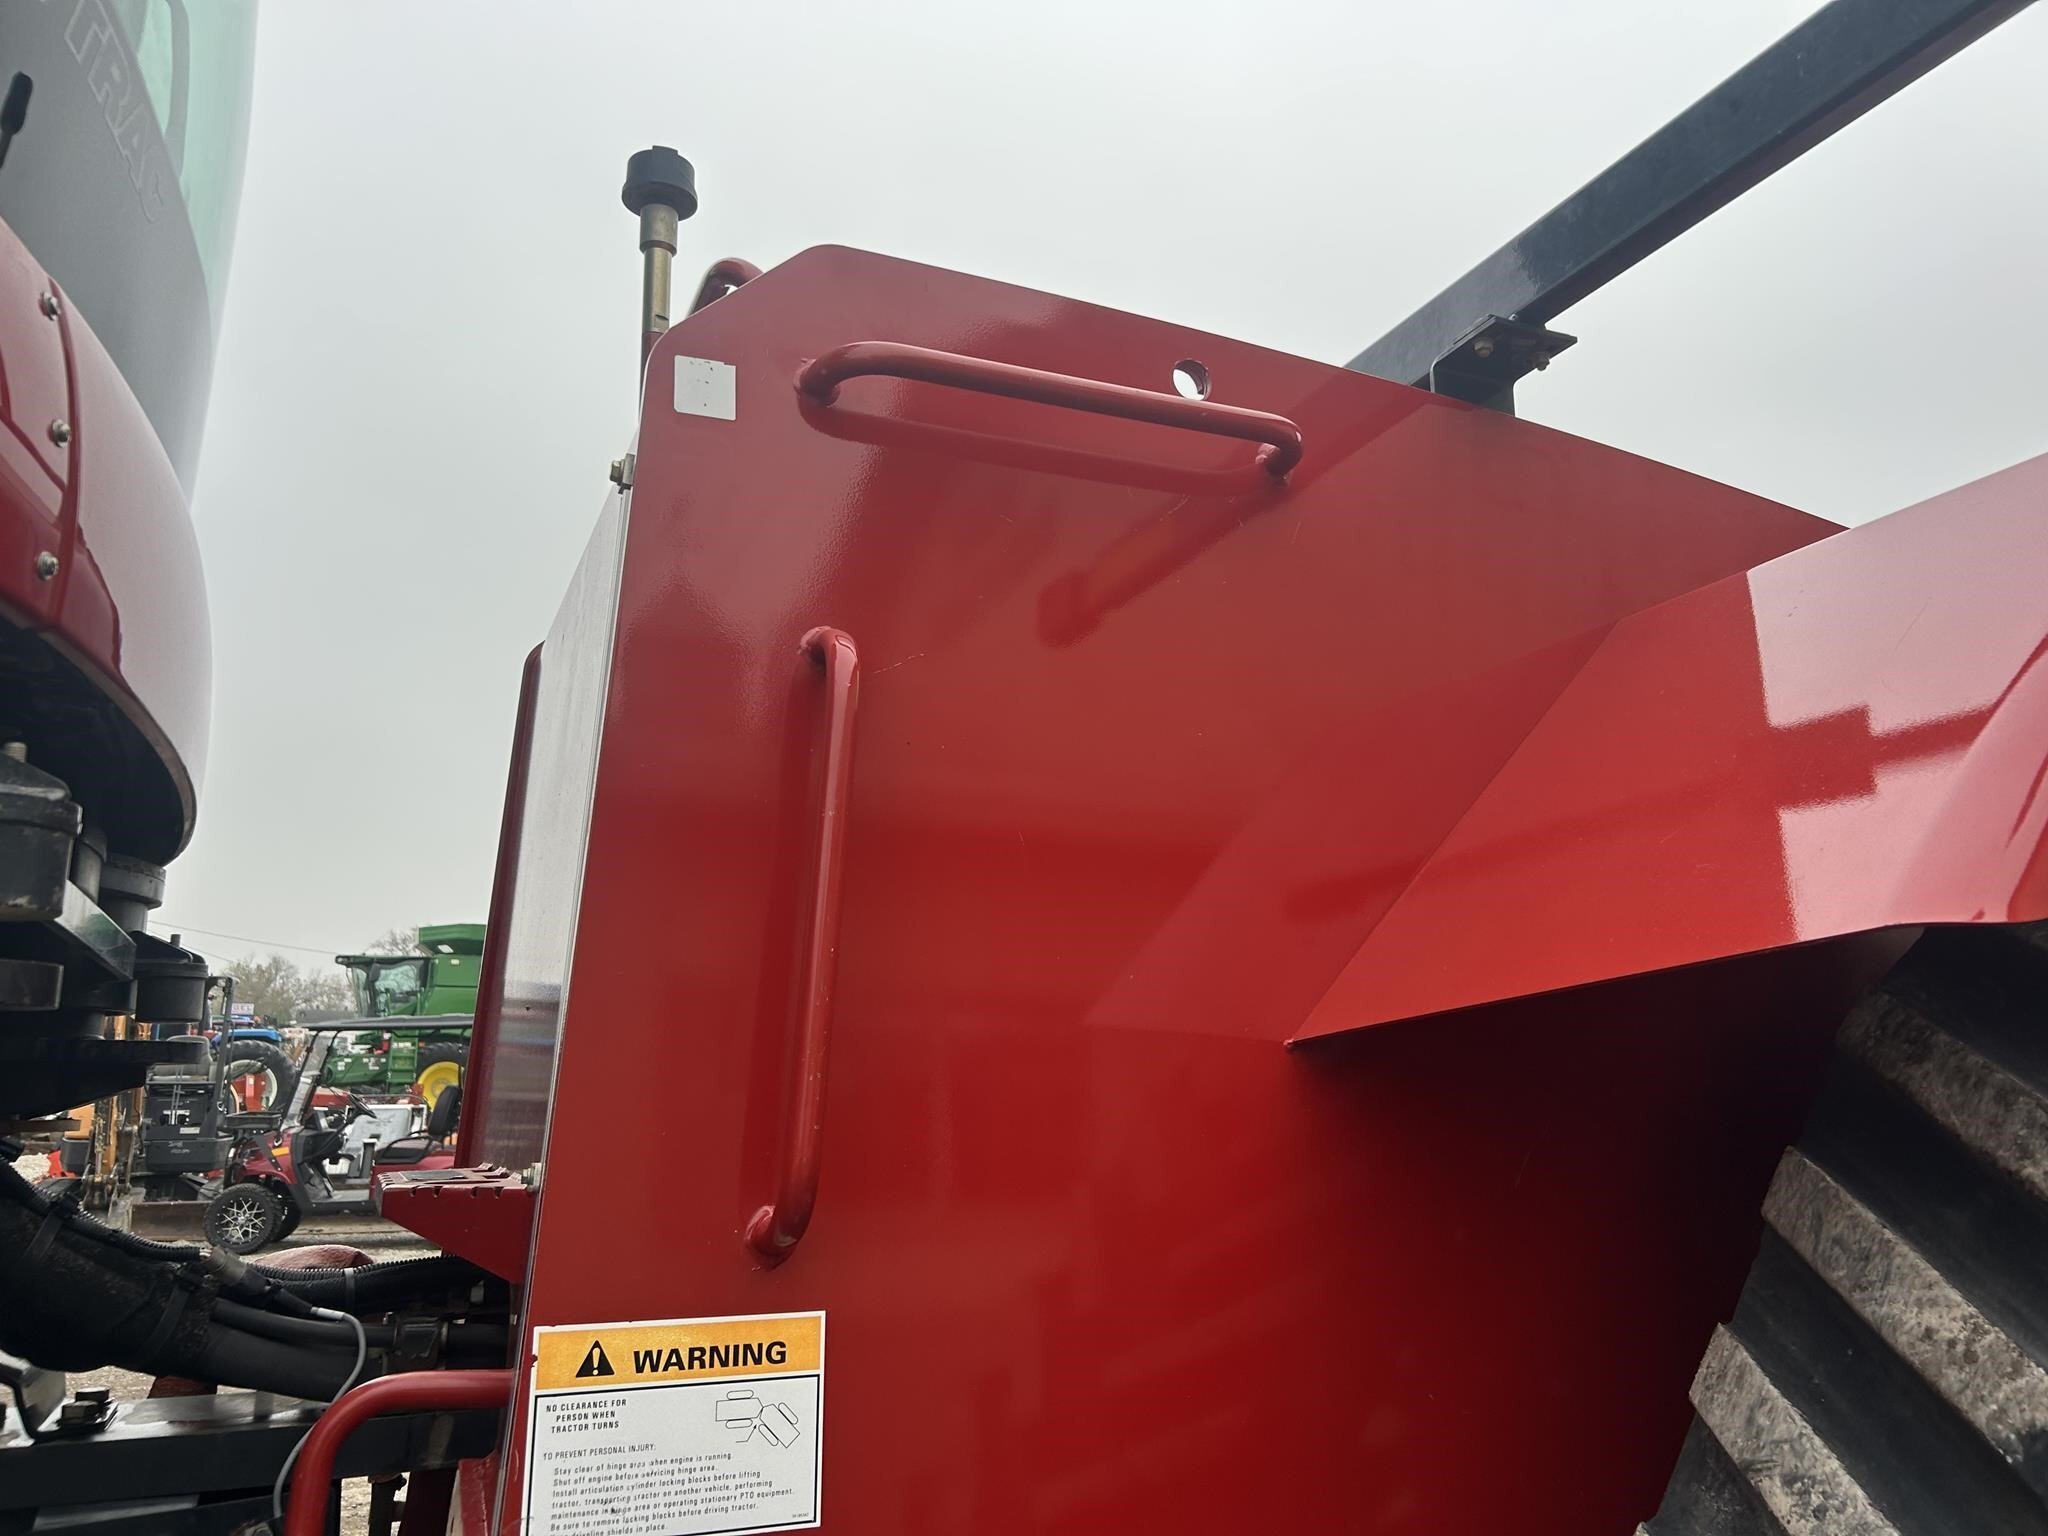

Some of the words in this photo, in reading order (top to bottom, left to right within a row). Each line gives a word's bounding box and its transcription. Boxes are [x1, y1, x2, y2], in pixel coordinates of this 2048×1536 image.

[60, 0, 166, 224] TRAC
[633, 1341, 786, 1374] WARNING
[546, 1404, 557, 1413] NO
[561, 1400, 607, 1411] CLEARANCE
[611, 1399, 627, 1407] FOR
[556, 1412, 589, 1422] PERSON
[592, 1410, 616, 1419] WHEN
[551, 1423, 589, 1434] TRACTOR
[592, 1421, 619, 1430] TURNS
[543, 1452, 553, 1460] TO
[555, 1449, 587, 1459] PREVENT
[589, 1446, 626, 1456] PERSONAL
[628, 1443, 656, 1453] INJURY:
[554, 1467, 571, 1476] Stay
[574, 1466, 593, 1474] clear
[596, 1463, 604, 1471] of
[607, 1462, 627, 1471] hinge
[670, 1456, 694, 1465] engine
[552, 1488, 578, 1497] Install
[580, 1485, 624, 1495] articulation
[659, 1478, 685, 1486] locking
[688, 1476, 711, 1484] blocks
[714, 1473, 736, 1481] before
[739, 1471, 761, 1479] lifting
[553, 1478, 571, 1487] Shut
[574, 1476, 586, 1485] off
[588, 1475, 612, 1484] engine
[615, 1473, 639, 1481] before
[585, 1496, 631, 1506] transporting
[634, 1492, 660, 1501] tractor
[675, 1487, 702, 1496] another
[734, 1480, 773, 1491] performing
[551, 1509, 599, 1520] maintenance
[663, 1499, 698, 1509] operating
[700, 1495, 737, 1504] stationary
[740, 1492, 754, 1500] PTO
[550, 1523, 560, 1532] Be
[563, 1522, 579, 1530] sure
[593, 1518, 620, 1527] remove
[622, 1515, 649, 1524] locking
[652, 1511, 675, 1520] blocks
[678, 1509, 702, 1517] before
[608, 1526, 633, 1536] shields
